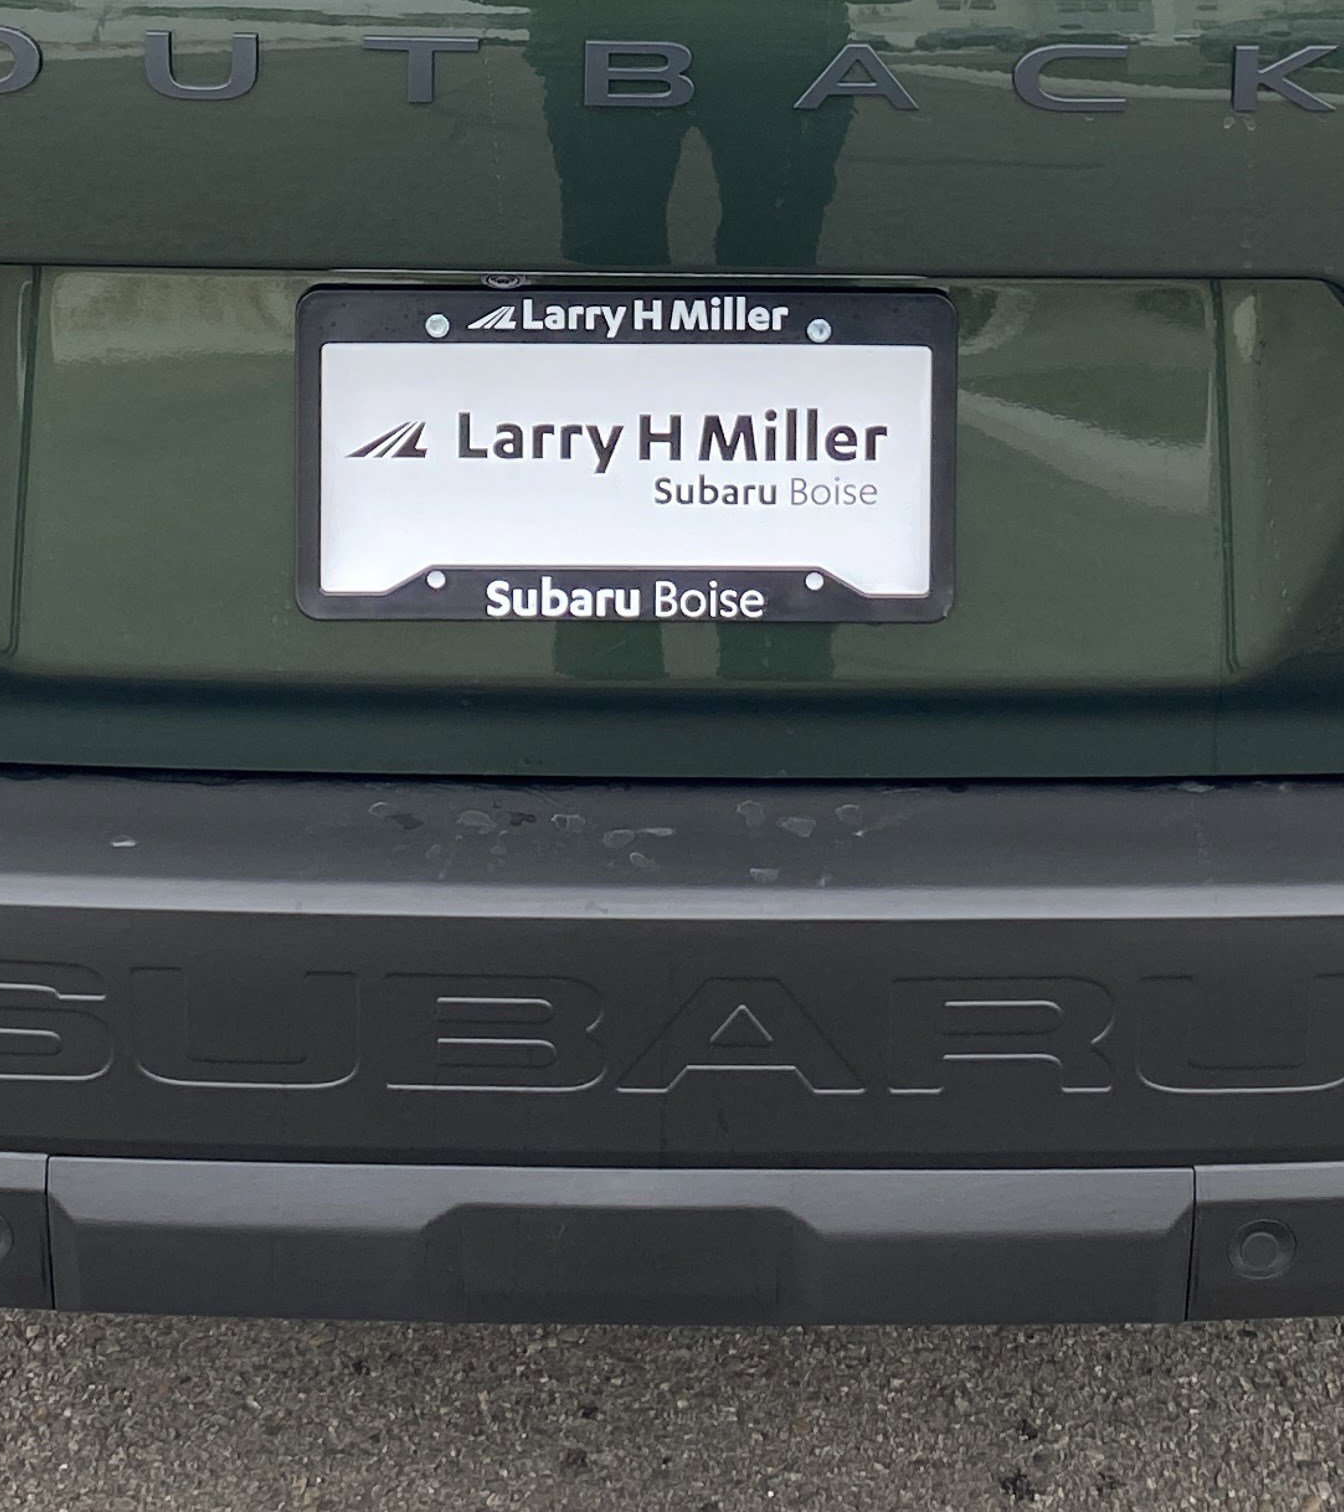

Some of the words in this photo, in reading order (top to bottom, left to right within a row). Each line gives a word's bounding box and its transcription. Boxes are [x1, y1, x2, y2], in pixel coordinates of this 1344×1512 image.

[522, 298, 626, 338] Larry
[634, 299, 663, 331] H
[670, 296, 789, 332] Miller
[457, 411, 625, 474] Larry
[639, 414, 682, 462] H
[699, 408, 888, 462] Miller
[654, 476, 778, 506] Subaru
[789, 477, 878, 506] Boise
[485, 577, 640, 619] Subaru
[655, 580, 765, 619] Boise
